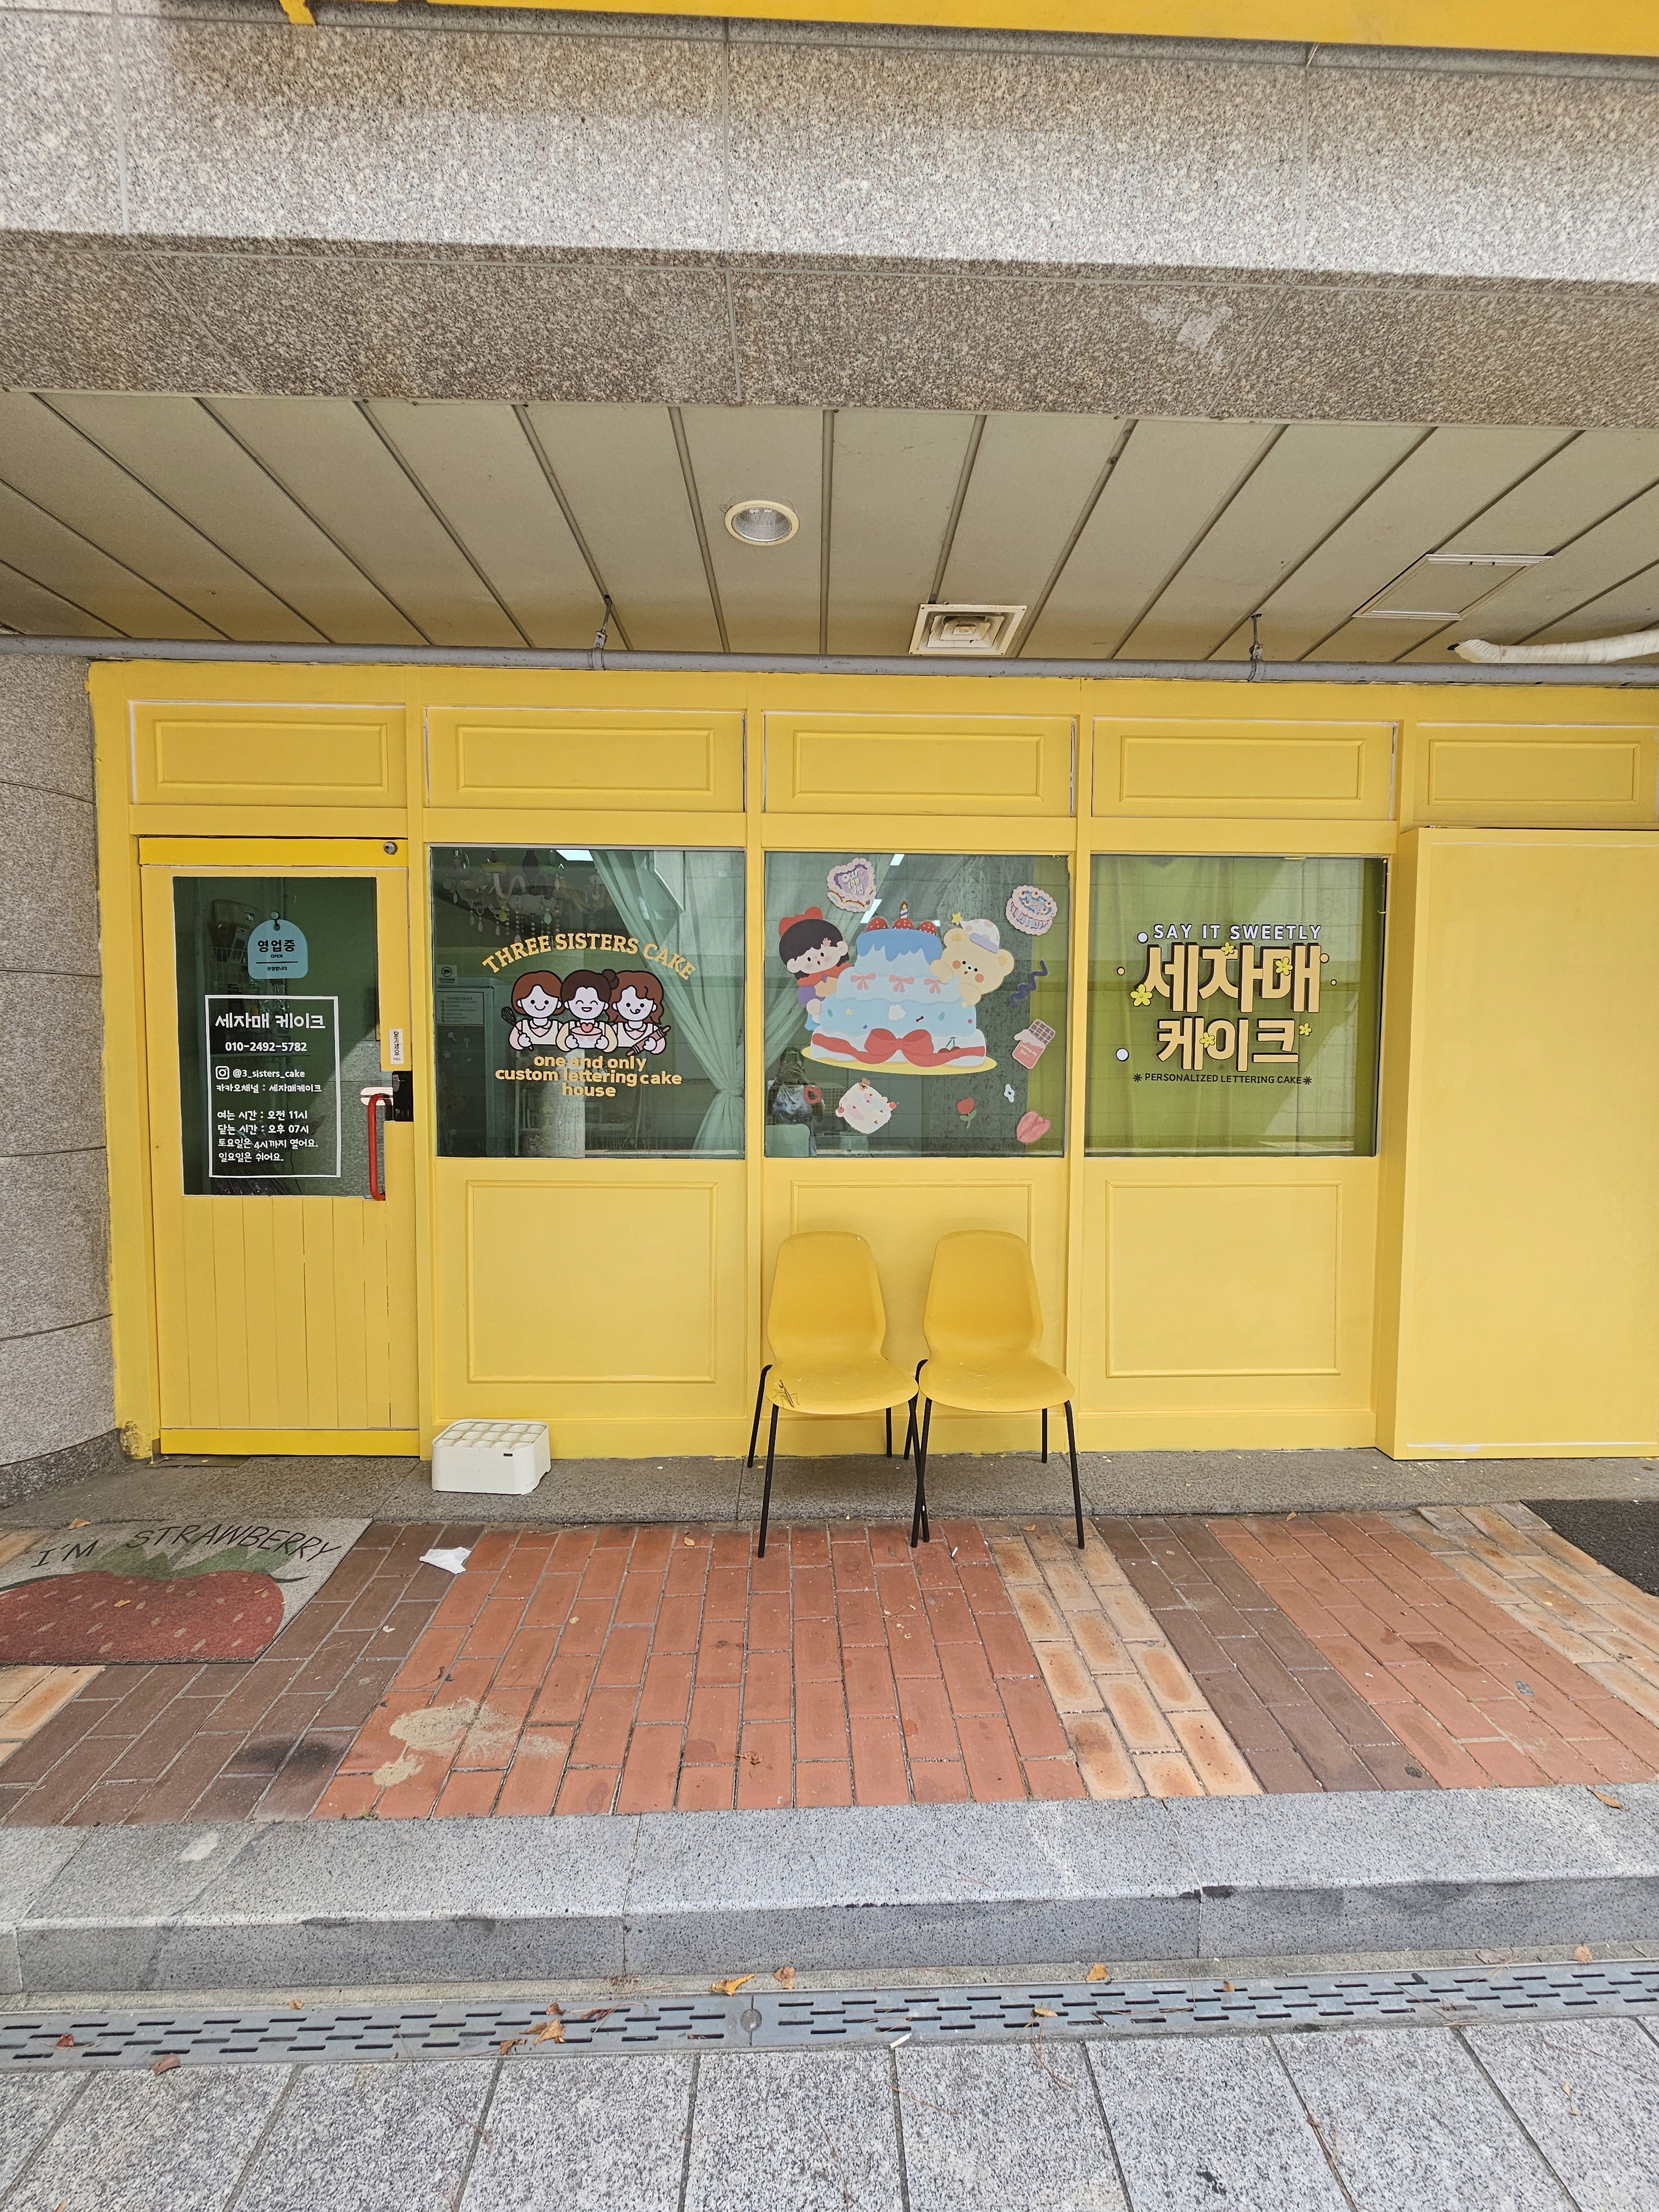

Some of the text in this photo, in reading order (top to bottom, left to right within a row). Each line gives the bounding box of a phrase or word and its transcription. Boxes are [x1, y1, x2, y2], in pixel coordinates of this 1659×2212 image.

[1153, 924, 1322, 941] SAY IT SWEETLY
[258, 940, 295, 952] 영업중
[482, 932, 696, 980] THREE SISTERS CAKE
[1138, 942, 1322, 1013] 세자매
[215, 1013, 326, 1029] 세자매 케이크
[225, 1042, 307, 1051] 010-2492-5782
[1157, 1016, 1300, 1072] 케이크
[534, 1056, 646, 1072] one and only
[233, 1069, 305, 1078] @3_sisters_cake
[495, 1068, 682, 1087] custom lettering cake
[1145, 1073, 1302, 1084] PERSONALIZED LETTERING CAKE
[216, 1084, 259, 1093] 카카오채널
[269, 1084, 322, 1093] 세자매케이크
[562, 1085, 617, 1097] house
[217, 1110, 235, 1120] 여는
[238, 1110, 257, 1120] 시간
[267, 1110, 285, 1120] 오전
[289, 1110, 307, 1119] 11시
[217, 1124, 236, 1135] 닫는
[239, 1124, 258, 1135] 시간
[268, 1124, 285, 1134] 오후
[288, 1124, 309, 1134] 07시
[218, 1139, 319, 1149] 토요일은 4시까지 열어요.
[218, 1152, 284, 1162] 일요일은 쉬어요.
[30, 1523, 342, 1569] I'M STRAWBERRY
